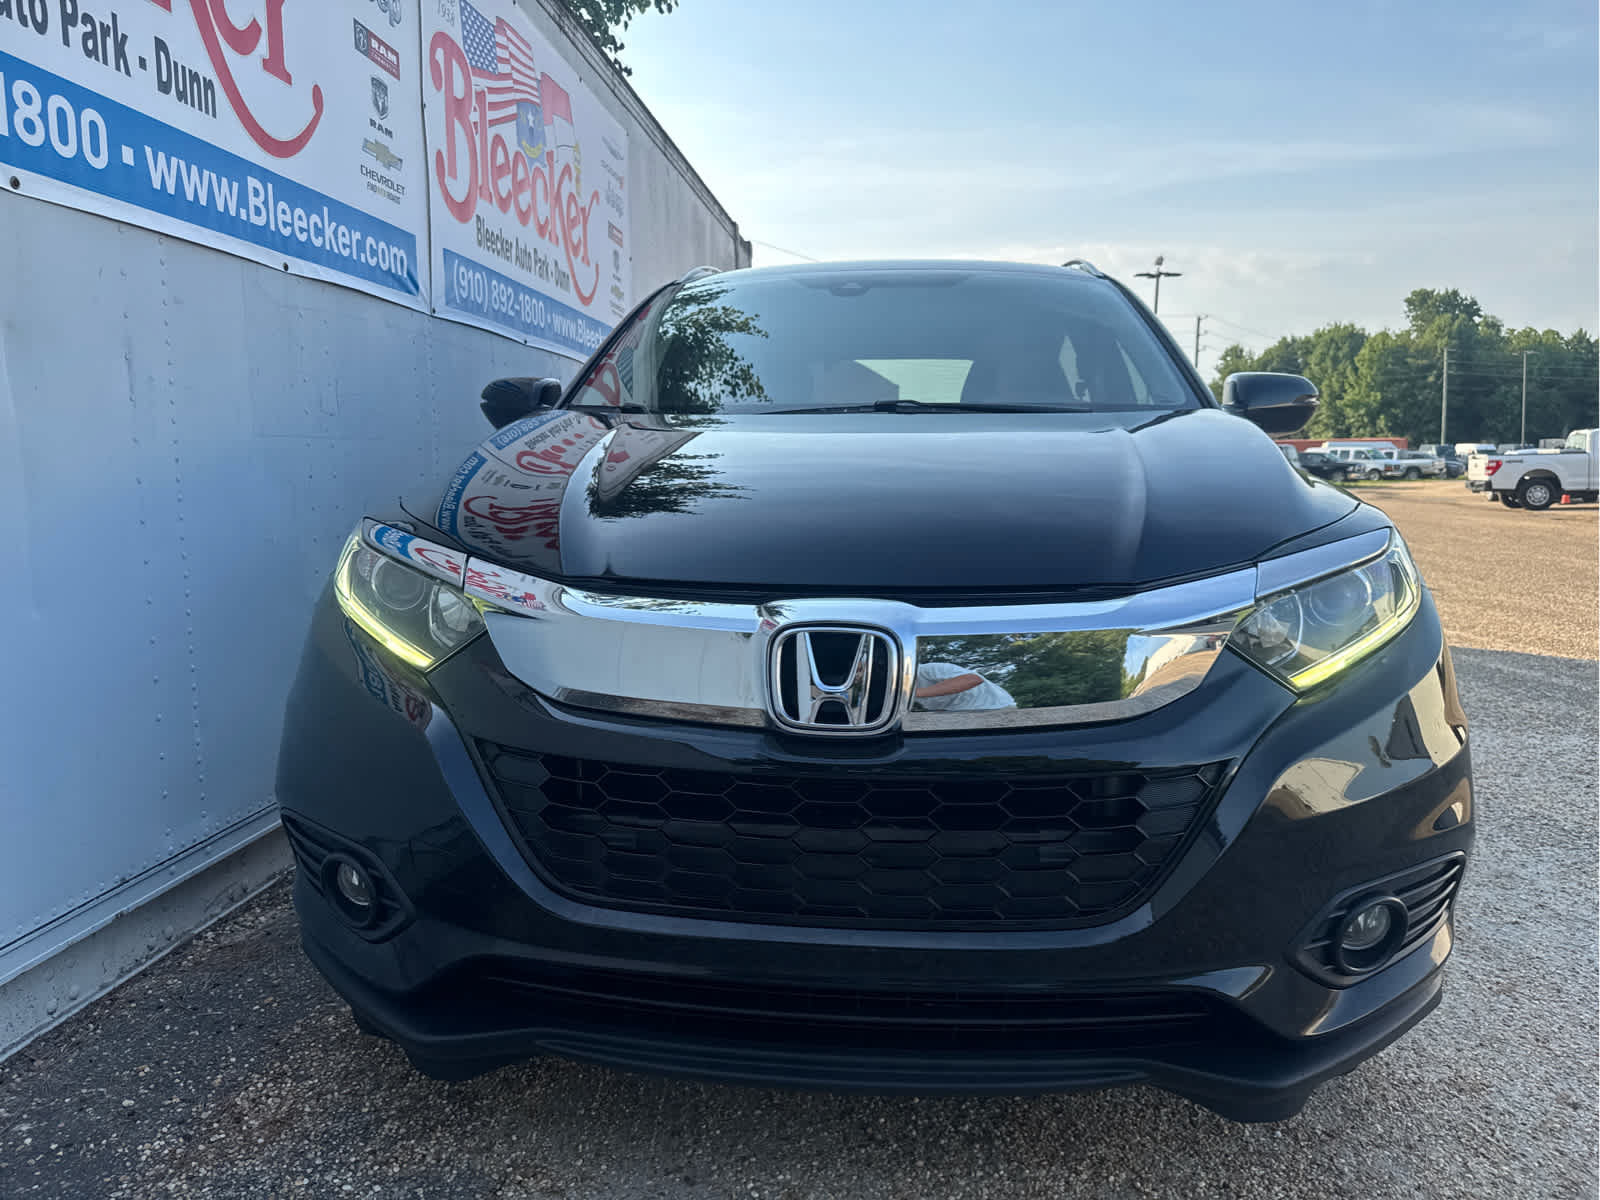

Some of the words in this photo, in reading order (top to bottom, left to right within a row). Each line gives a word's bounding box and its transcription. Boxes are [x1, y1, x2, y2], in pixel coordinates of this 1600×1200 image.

[60, 0, 132, 77] Park
[154, 35, 217, 119] Dunn
[369, 118, 393, 138] RAM
[360, 164, 405, 195] CHEVROLET
[429, 31, 600, 306] Bleecker
[144, 145, 409, 279] www.Bleecker.com
[475, 214, 513, 263] Bleecker
[514, 237, 532, 273] Auto
[453, 260, 488, 312] (910)
[491, 279, 544, 329] 892-1800
